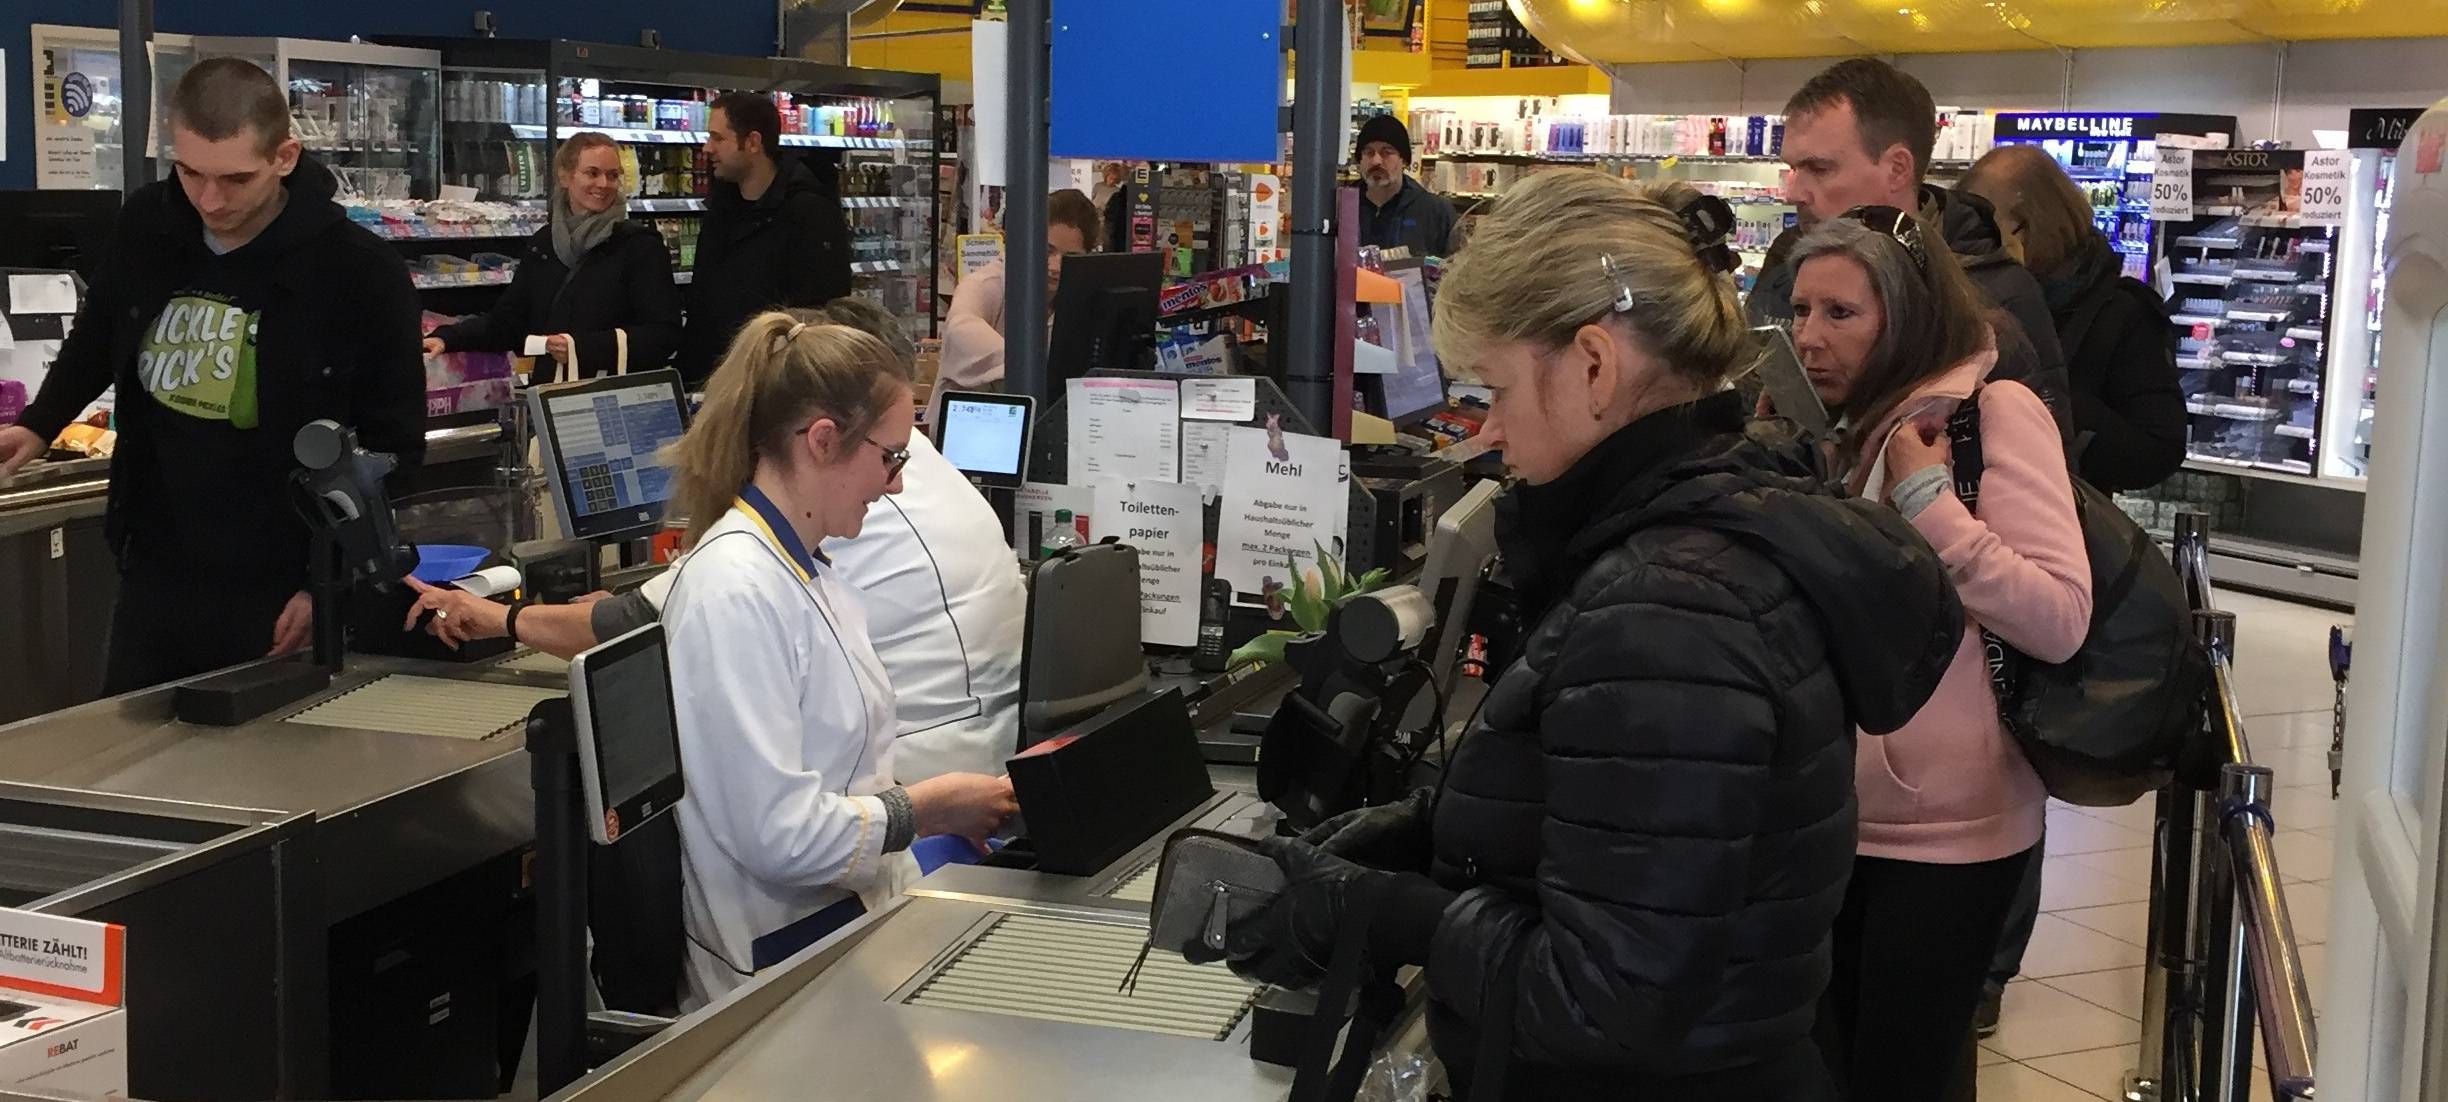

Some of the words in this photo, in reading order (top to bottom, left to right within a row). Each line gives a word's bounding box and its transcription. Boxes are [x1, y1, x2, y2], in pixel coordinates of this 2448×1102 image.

[2017, 117, 2133, 131] MAYBELLINE
[2162, 153, 2186, 165] Astor
[2224, 152, 2269, 167] ASTOR
[2311, 156, 2341, 167] Astor
[2154, 168, 2191, 177] Kosmetik
[2303, 171, 2347, 180] Kosmetik
[2154, 183, 2188, 201] 50%
[2303, 186, 2342, 205] 50%
[2152, 205, 2189, 215] reduziert
[2302, 209, 2342, 219] reduziert
[1162, 281, 1208, 309] mentos
[154, 303, 244, 344] ICKLE
[138, 341, 235, 393] PICK'S
[1265, 461, 1302, 477] Mehl
[1120, 501, 1181, 516] Toiletten-
[1253, 499, 1282, 510] Abgabe
[1243, 513, 1314, 528] Haushaltsüblicher
[1129, 527, 1170, 540] papier
[1264, 529, 1291, 540] Menge
[1137, 548, 1151, 556] abe
[1167, 549, 1175, 558] in
[1241, 542, 1258, 551] max.
[1262, 543, 1268, 552] 2
[1140, 563, 1181, 573] ltsüblicher
[1253, 559, 1267, 567] pro
[1268, 560, 1296, 569] Einka
[1141, 578, 1160, 586] enge
[1141, 605, 1167, 615] inkauf
[43, 938, 88, 961] ZÄHLT!
[47, 1038, 79, 1059] REBAT
